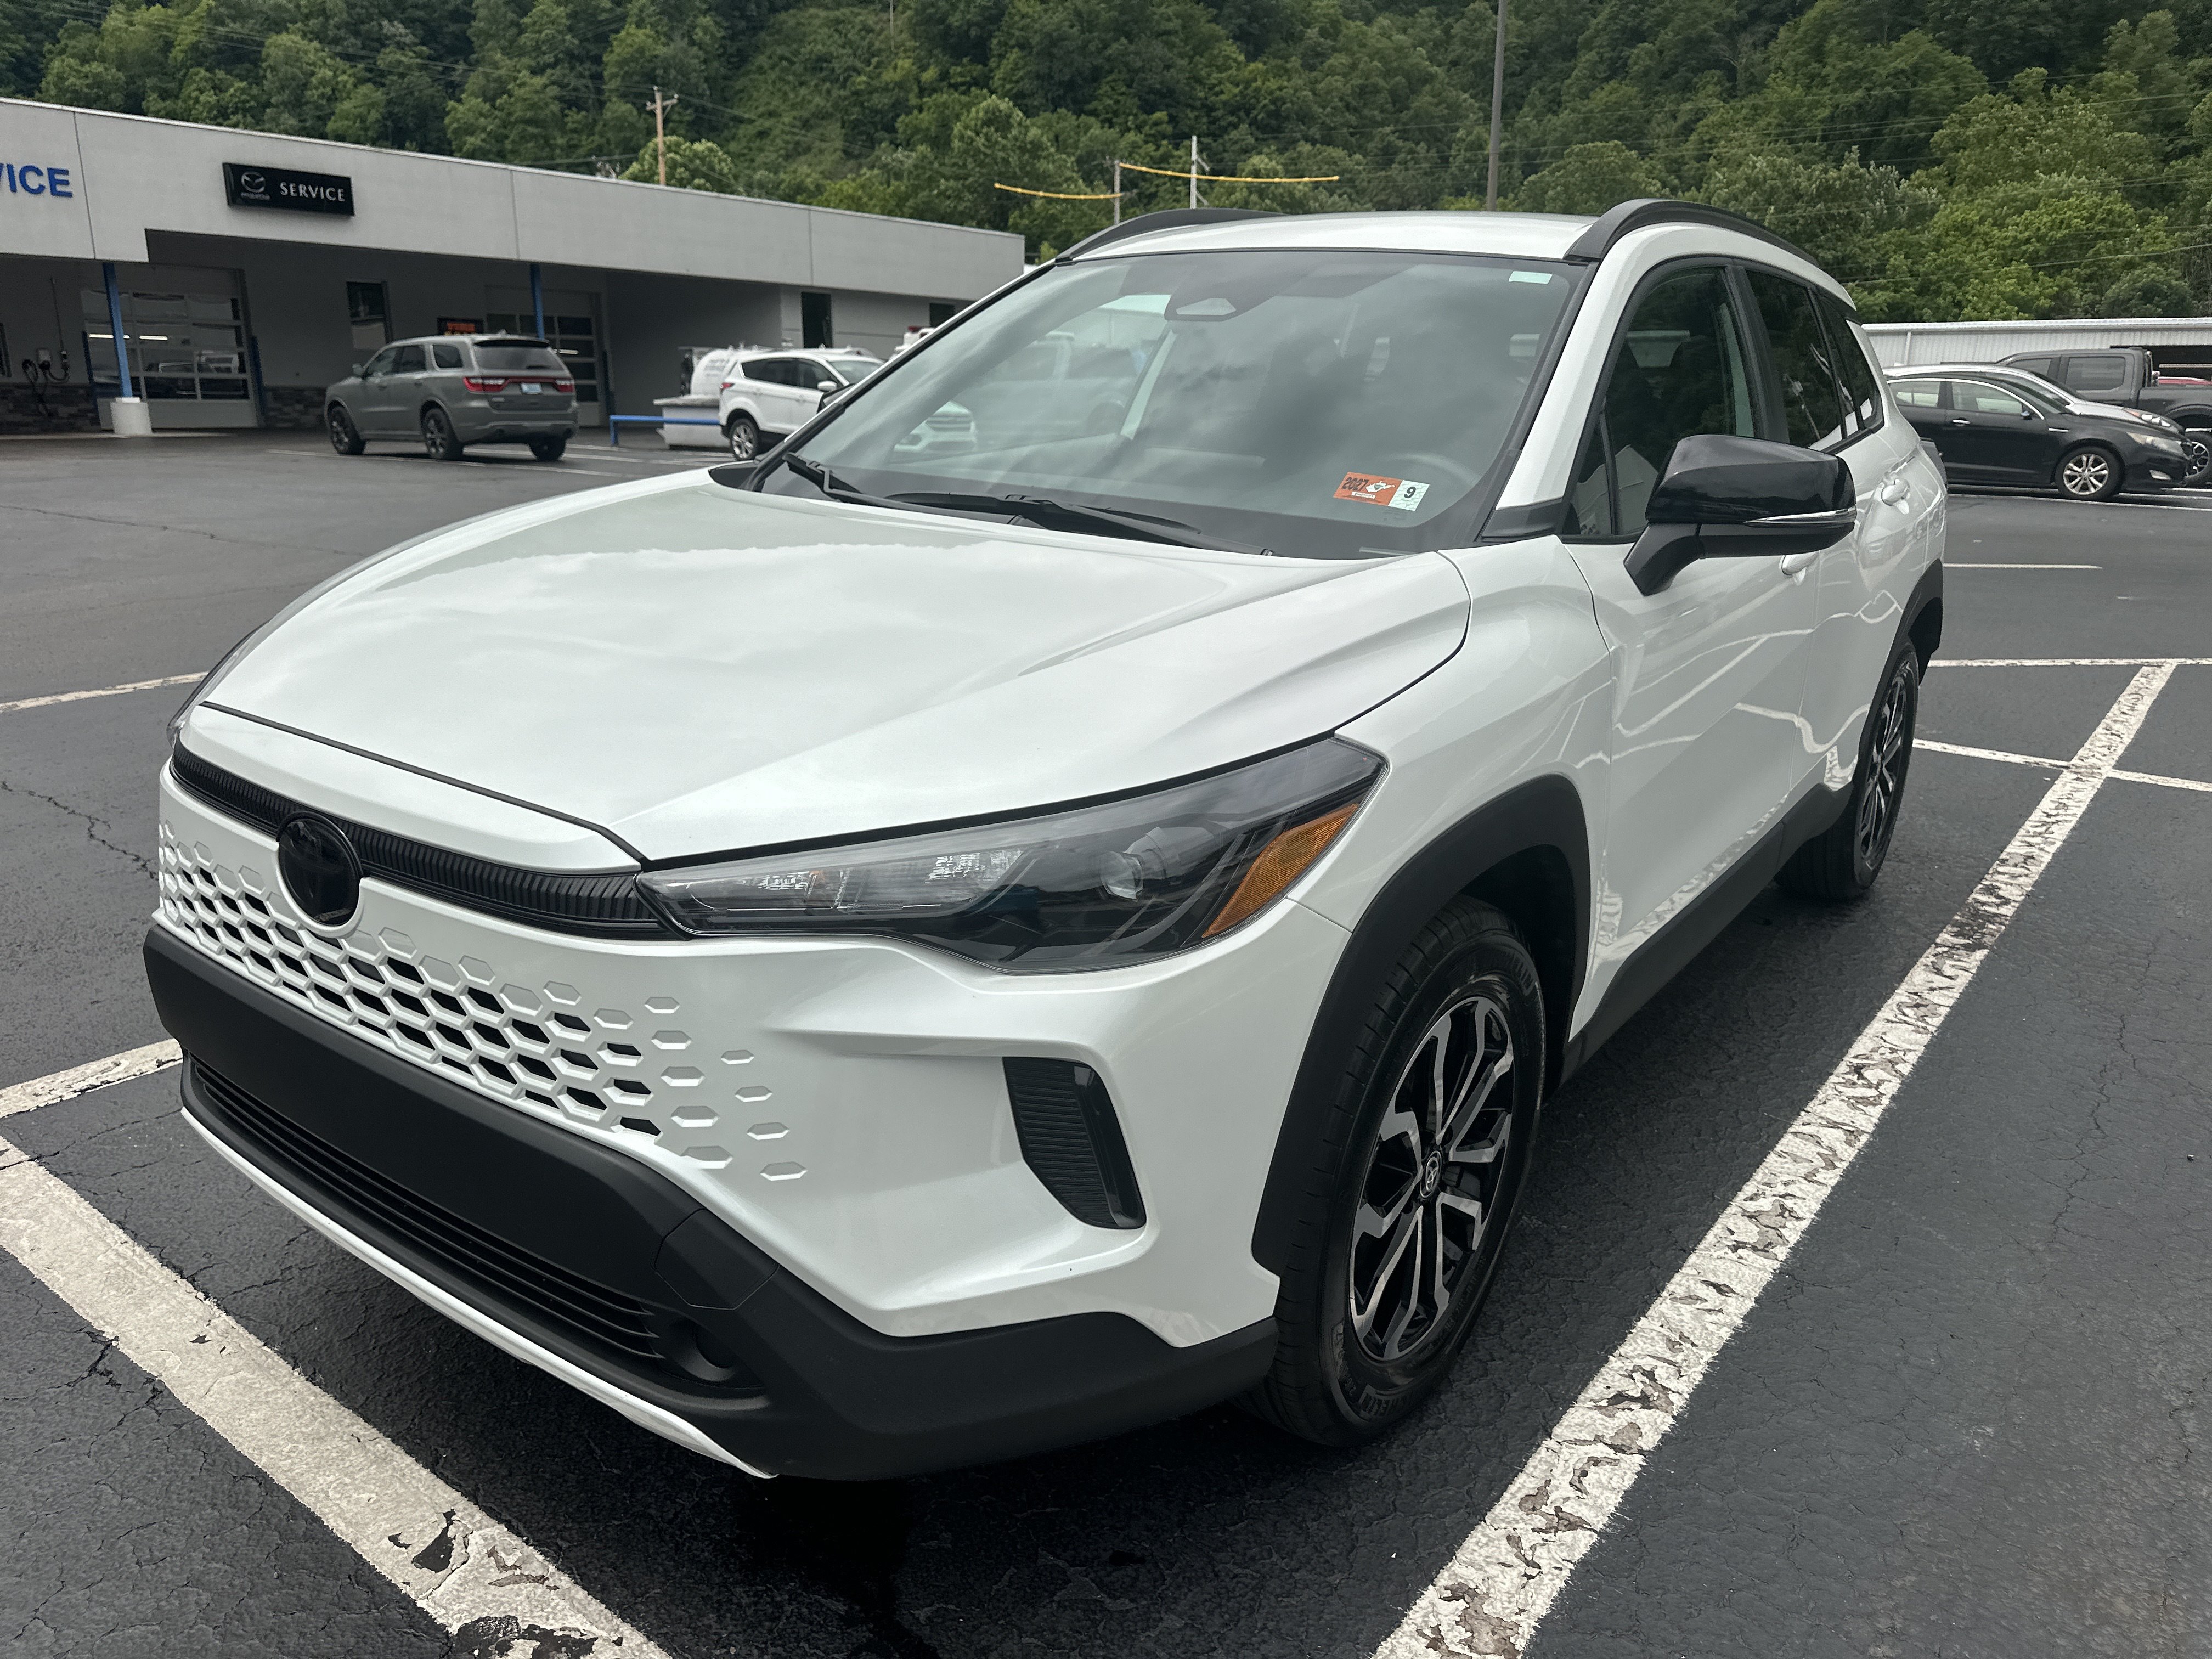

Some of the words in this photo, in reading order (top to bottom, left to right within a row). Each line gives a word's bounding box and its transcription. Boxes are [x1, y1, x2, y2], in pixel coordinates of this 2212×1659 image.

[0, 163, 73, 198] ICE
[280, 181, 346, 202] SERVICE
[1341, 477, 1369, 492] 2027
[1404, 486, 1417, 498] 9
